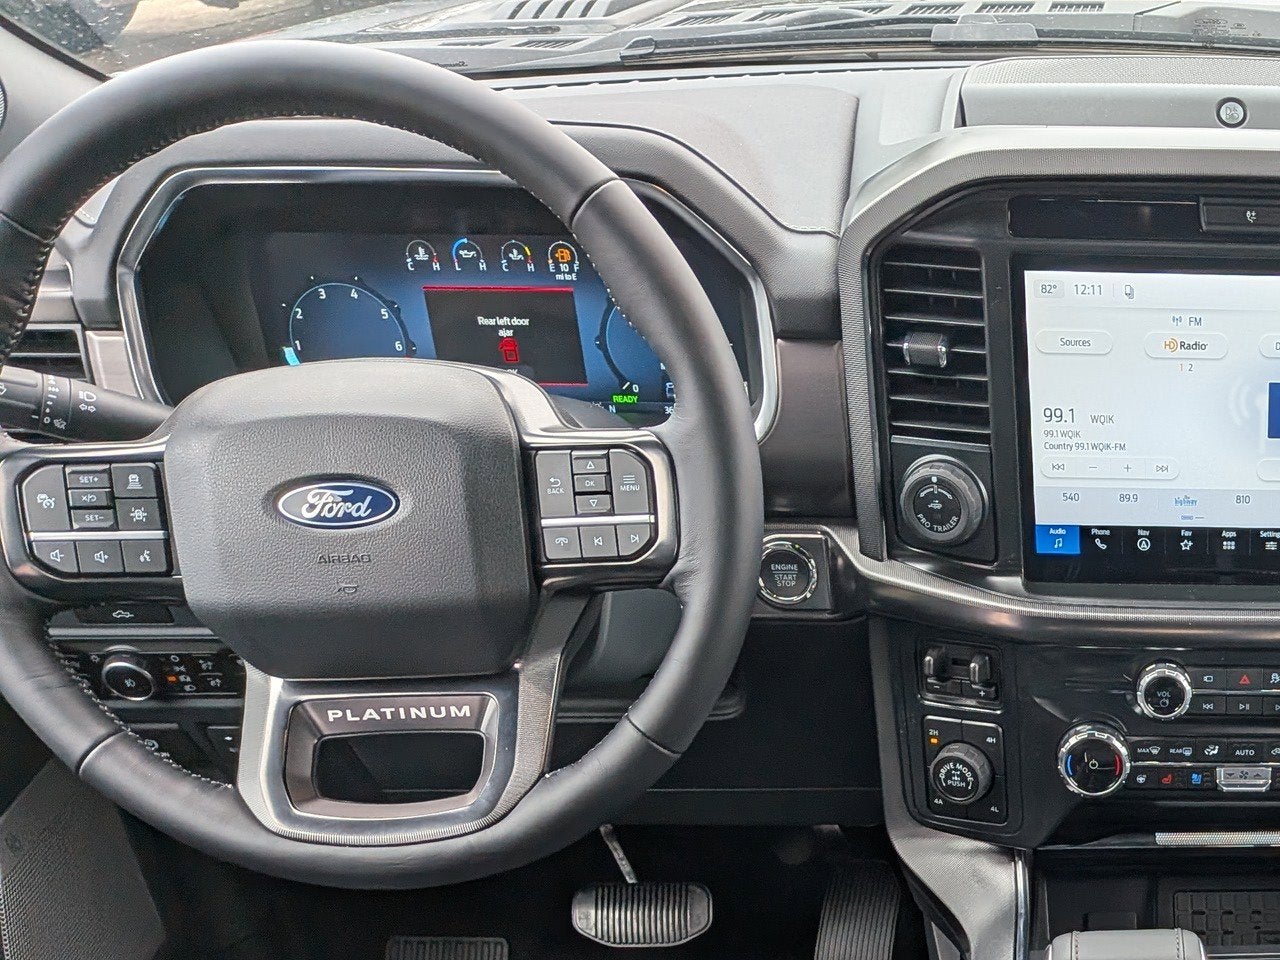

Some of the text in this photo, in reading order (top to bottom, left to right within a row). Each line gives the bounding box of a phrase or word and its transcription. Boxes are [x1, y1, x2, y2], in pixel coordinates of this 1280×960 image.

[433, 263, 440, 271] H
[479, 263, 486, 271] H
[560, 264, 569, 272] 10
[318, 289, 326, 299] 3
[350, 289, 358, 299] 4
[1040, 284, 1102, 296] 82° 12:11
[295, 308, 303, 319] 2
[381, 309, 388, 319] 5
[477, 316, 530, 326] Rear left door
[1188, 316, 1202, 326] FM
[498, 328, 514, 338] ajar
[295, 340, 301, 350] 1
[395, 341, 402, 351] 6
[1060, 338, 1091, 347] Sources
[1180, 341, 1208, 351] Radio
[1188, 363, 1194, 372] 2
[632, 384, 640, 392] 0
[608, 404, 616, 412] N
[1043, 407, 1114, 426] 99.1 WQIK
[1043, 429, 1081, 439] 99.1 WQIK
[1044, 442, 1126, 452] Country 99.1 WQIK-FM
[301, 489, 372, 518] Ford
[1062, 493, 1080, 502] 540
[1119, 493, 1138, 503] 89.9
[1236, 495, 1250, 504] 810
[917, 513, 960, 532] PRO TRAILER
[1091, 528, 1110, 536] Phone
[1222, 530, 1236, 538] Apps
[318, 554, 372, 564] AIRBAG
[327, 705, 470, 722] PLATINUM
[939, 762, 974, 782] DRIVE MODE
